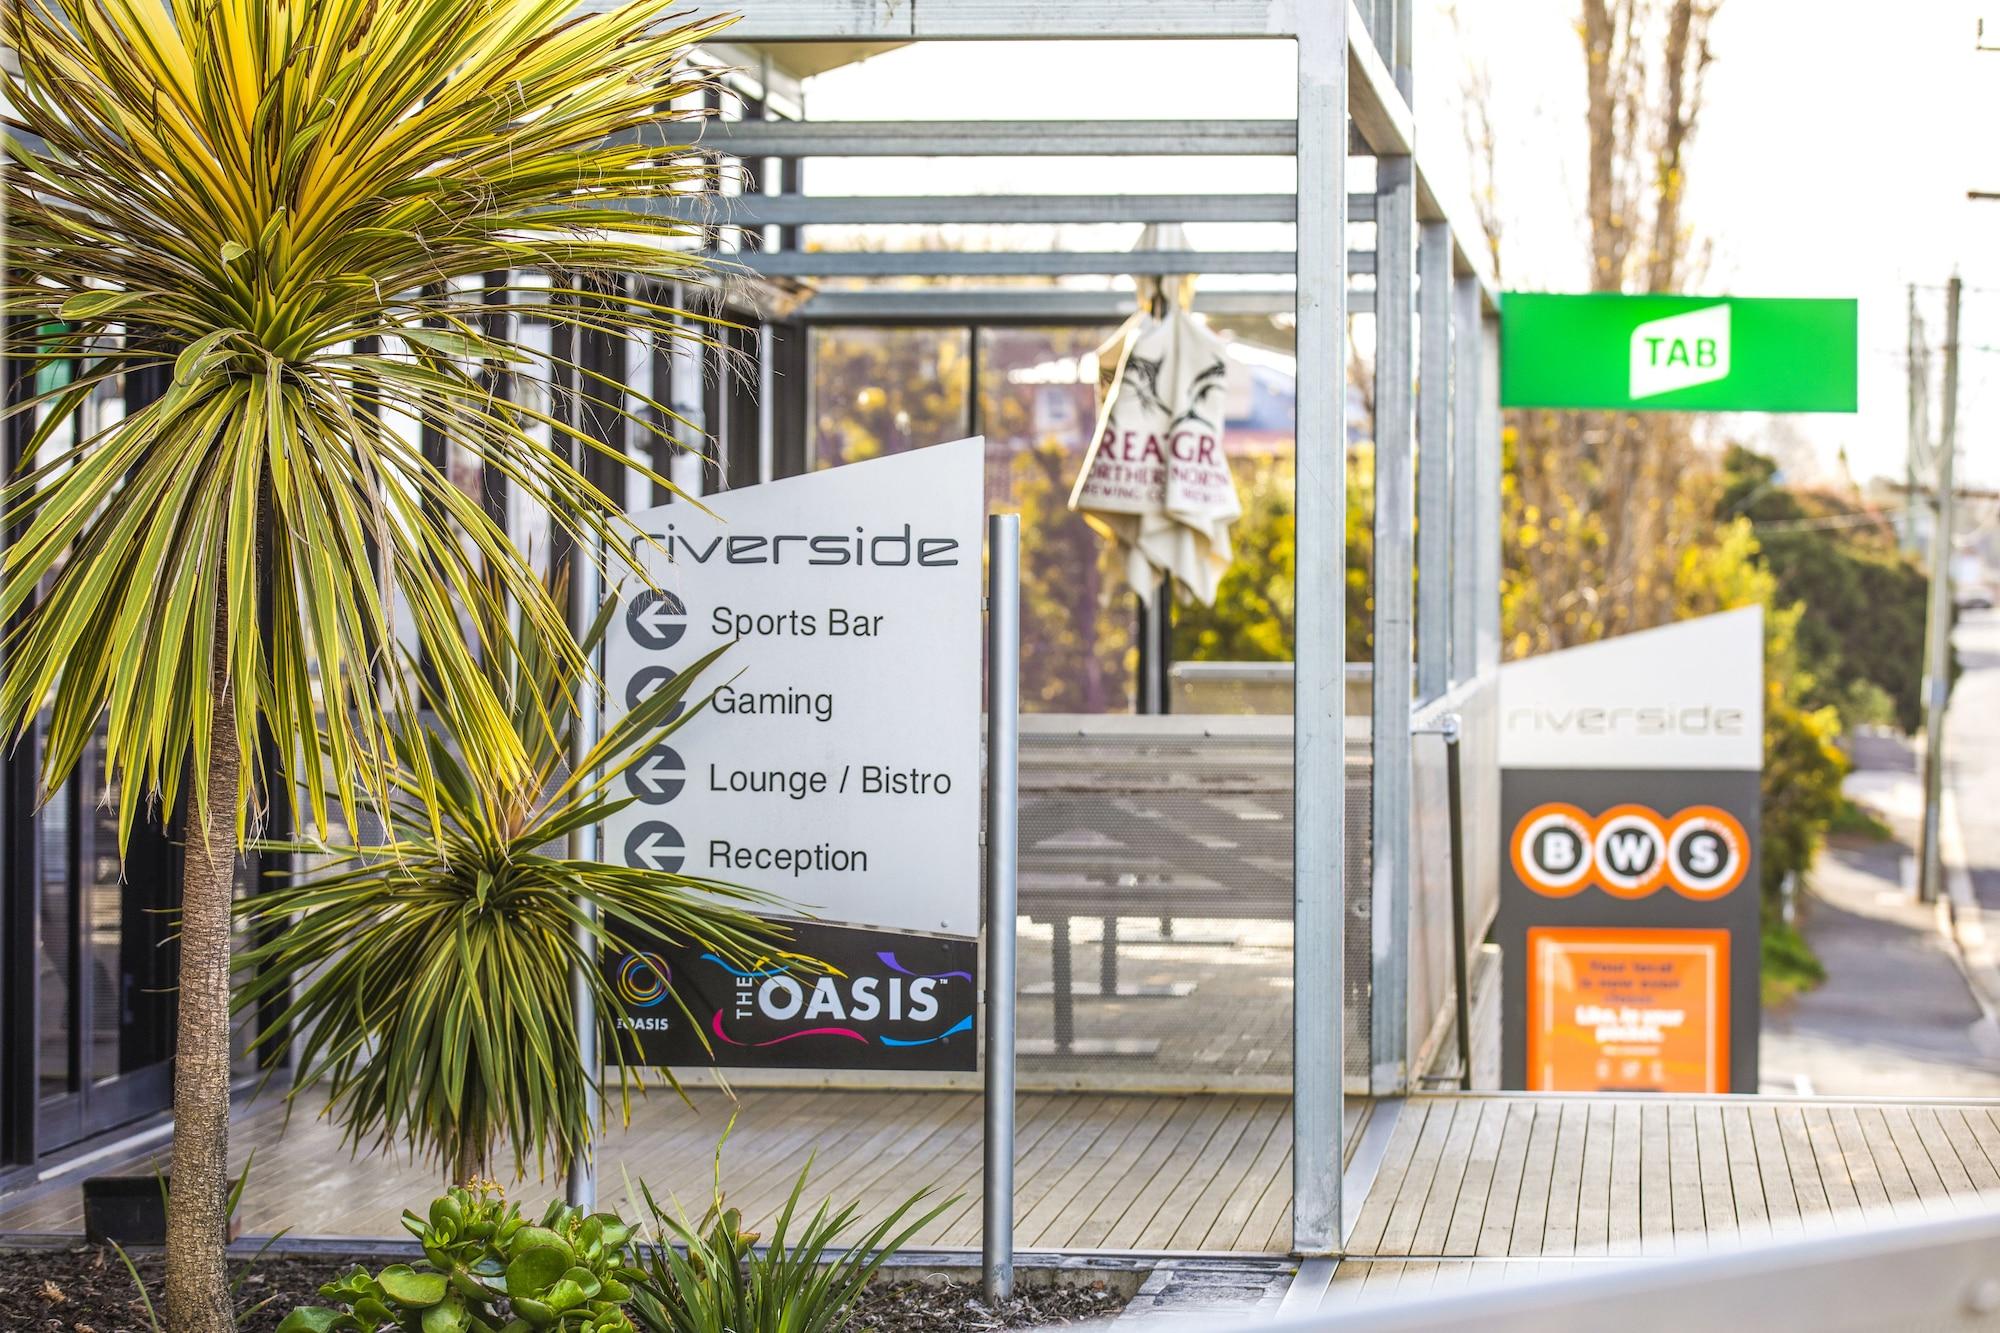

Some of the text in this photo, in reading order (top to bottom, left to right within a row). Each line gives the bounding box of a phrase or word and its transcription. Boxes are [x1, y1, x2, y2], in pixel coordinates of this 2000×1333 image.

[1643, 338, 1717, 367] TAB
[1097, 430, 1169, 464] REA
[629, 523, 959, 567] riverside
[712, 607, 883, 640] Sports Bar
[711, 686, 833, 722] Gaming
[1507, 704, 1744, 736] riverside
[711, 764, 951, 800] Lounge / Bistro
[709, 841, 868, 877] Reception
[737, 974, 752, 1019] THE
[622, 1017, 669, 1031] OASIS
